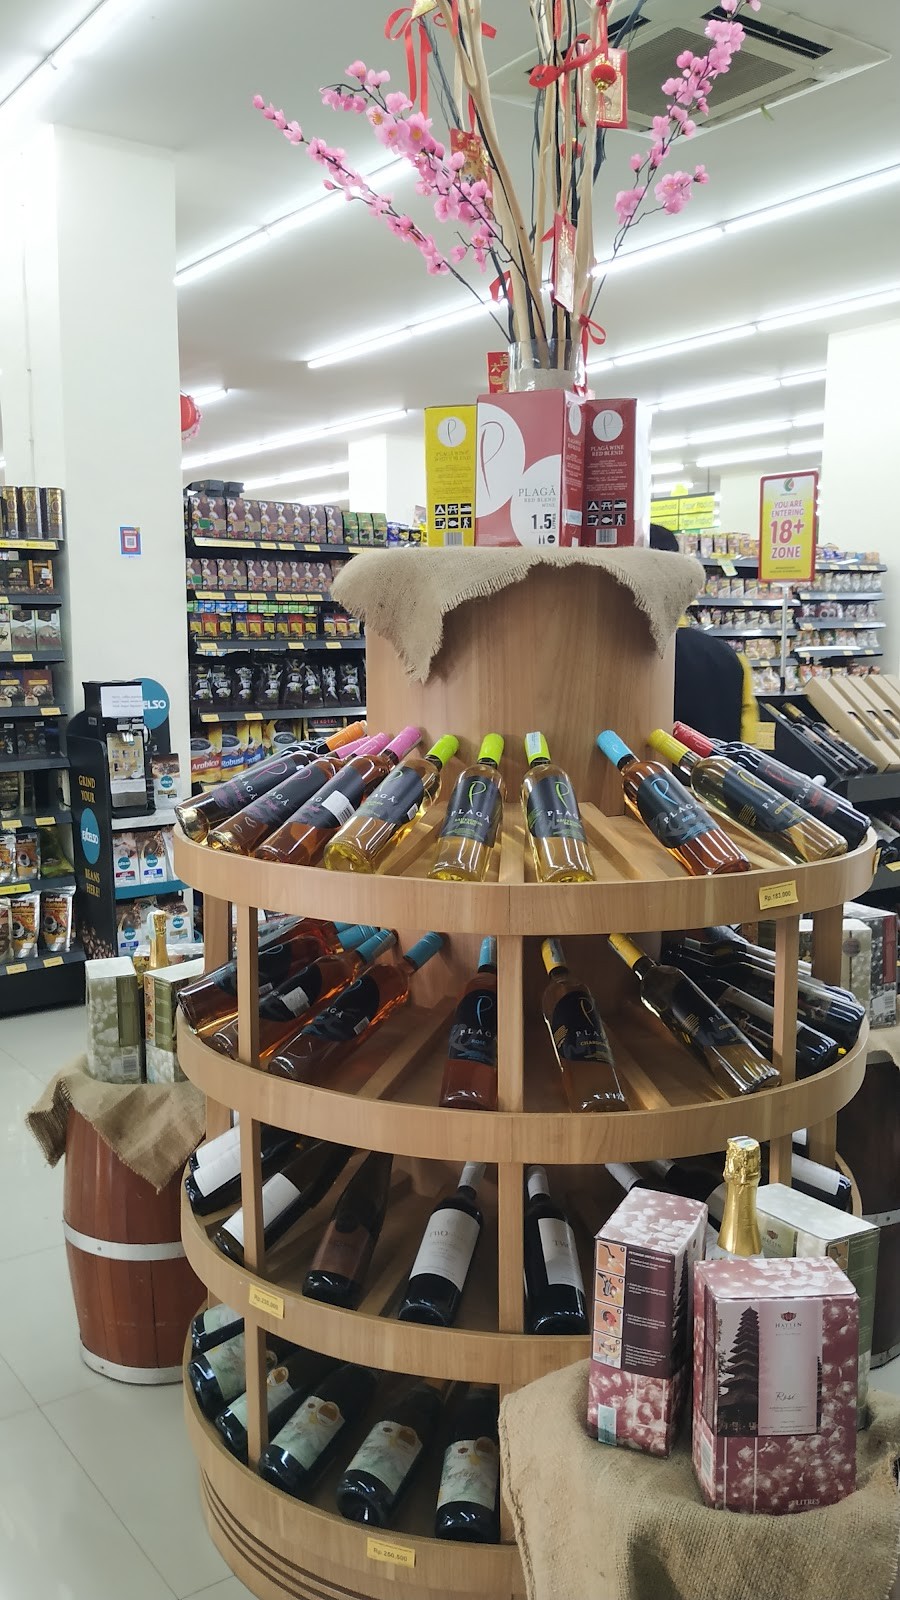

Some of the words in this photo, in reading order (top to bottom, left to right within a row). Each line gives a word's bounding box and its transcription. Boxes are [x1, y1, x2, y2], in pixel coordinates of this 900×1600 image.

[774, 500, 788, 509] YOU
[789, 499, 803, 507] ARE
[771, 507, 804, 518] ENTERING
[531, 513, 552, 530] 1.5
[770, 519, 804, 544] 18+
[771, 546, 801, 559] ZONE
[78, 775, 96, 789] GRIND
[81, 789, 96, 804] YOUR
[84, 868, 100, 884] BEANS
[775, 1321, 803, 1329] HATTEN
